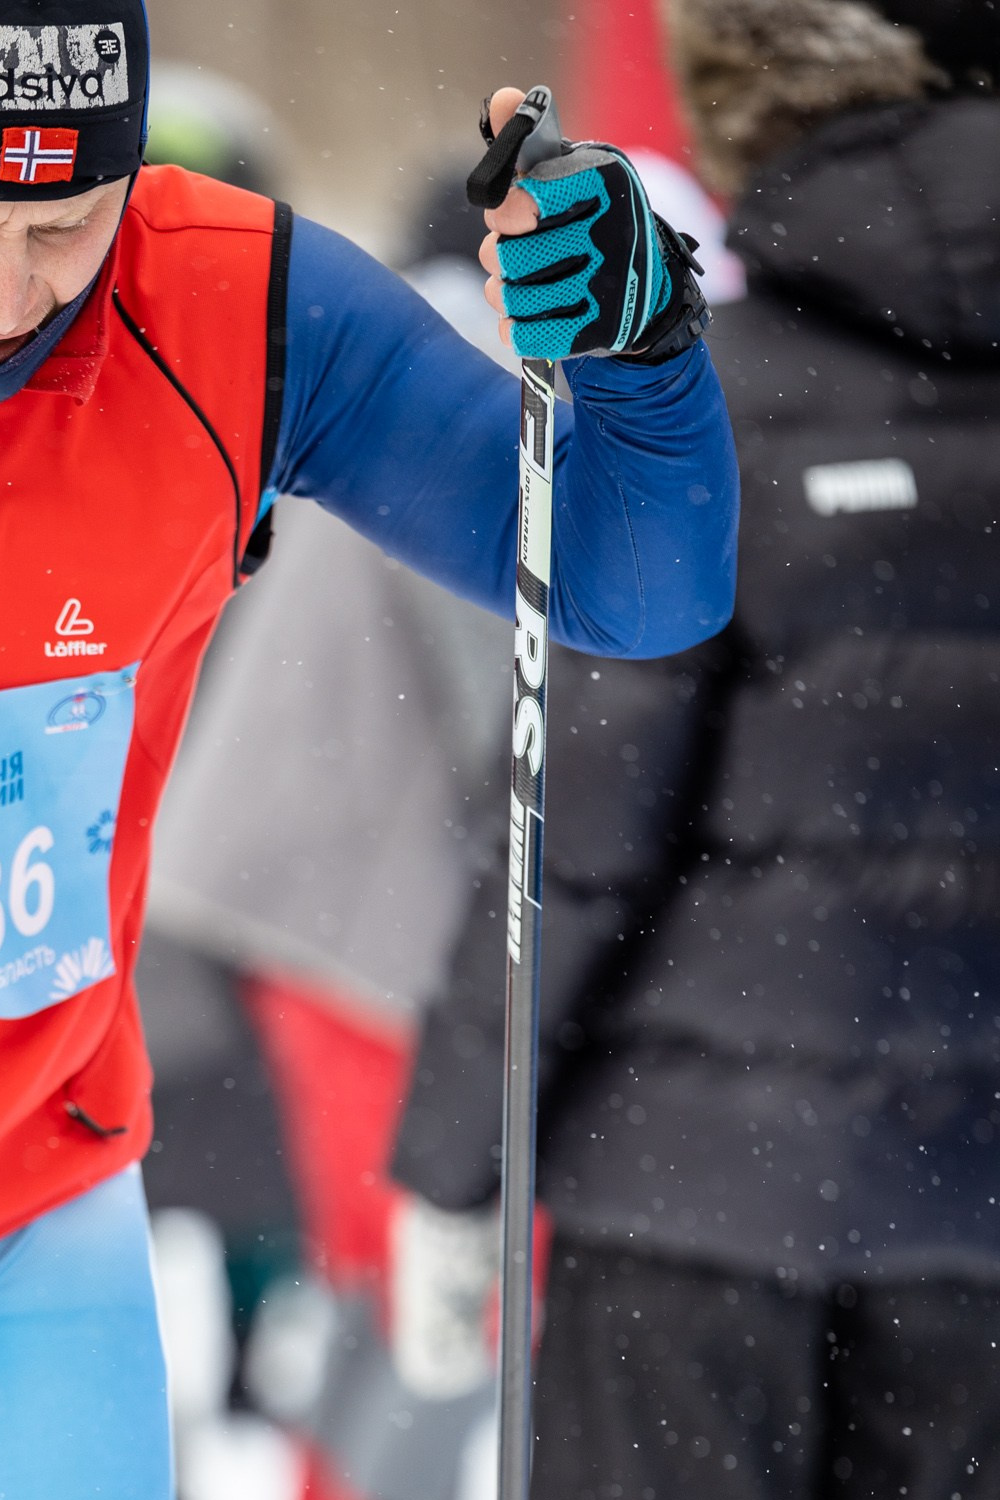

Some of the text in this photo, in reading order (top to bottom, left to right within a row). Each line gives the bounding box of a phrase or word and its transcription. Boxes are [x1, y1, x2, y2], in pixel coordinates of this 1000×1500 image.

[617, 278, 637, 345] VERLEGUNG
[522, 505, 530, 563] CARBON
[44, 640, 108, 657] Löffler
